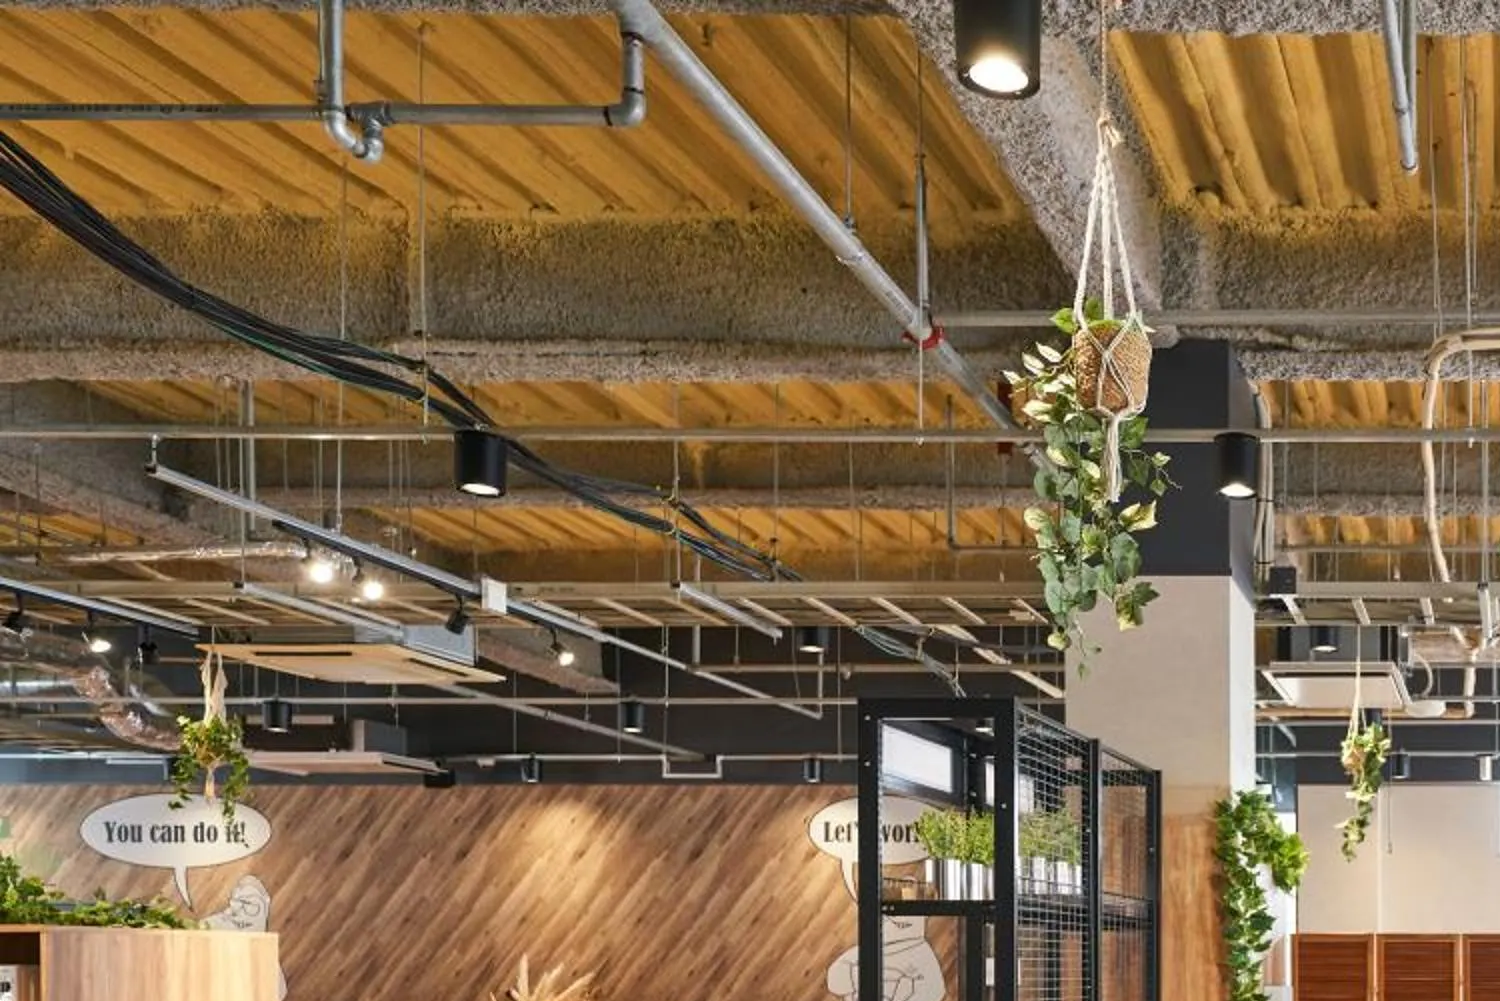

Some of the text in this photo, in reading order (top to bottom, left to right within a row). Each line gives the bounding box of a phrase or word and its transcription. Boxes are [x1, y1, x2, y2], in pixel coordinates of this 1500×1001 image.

[103, 821, 143, 843] You
[150, 824, 185, 843] can
[193, 821, 218, 843] do
[823, 821, 859, 843] Let'
